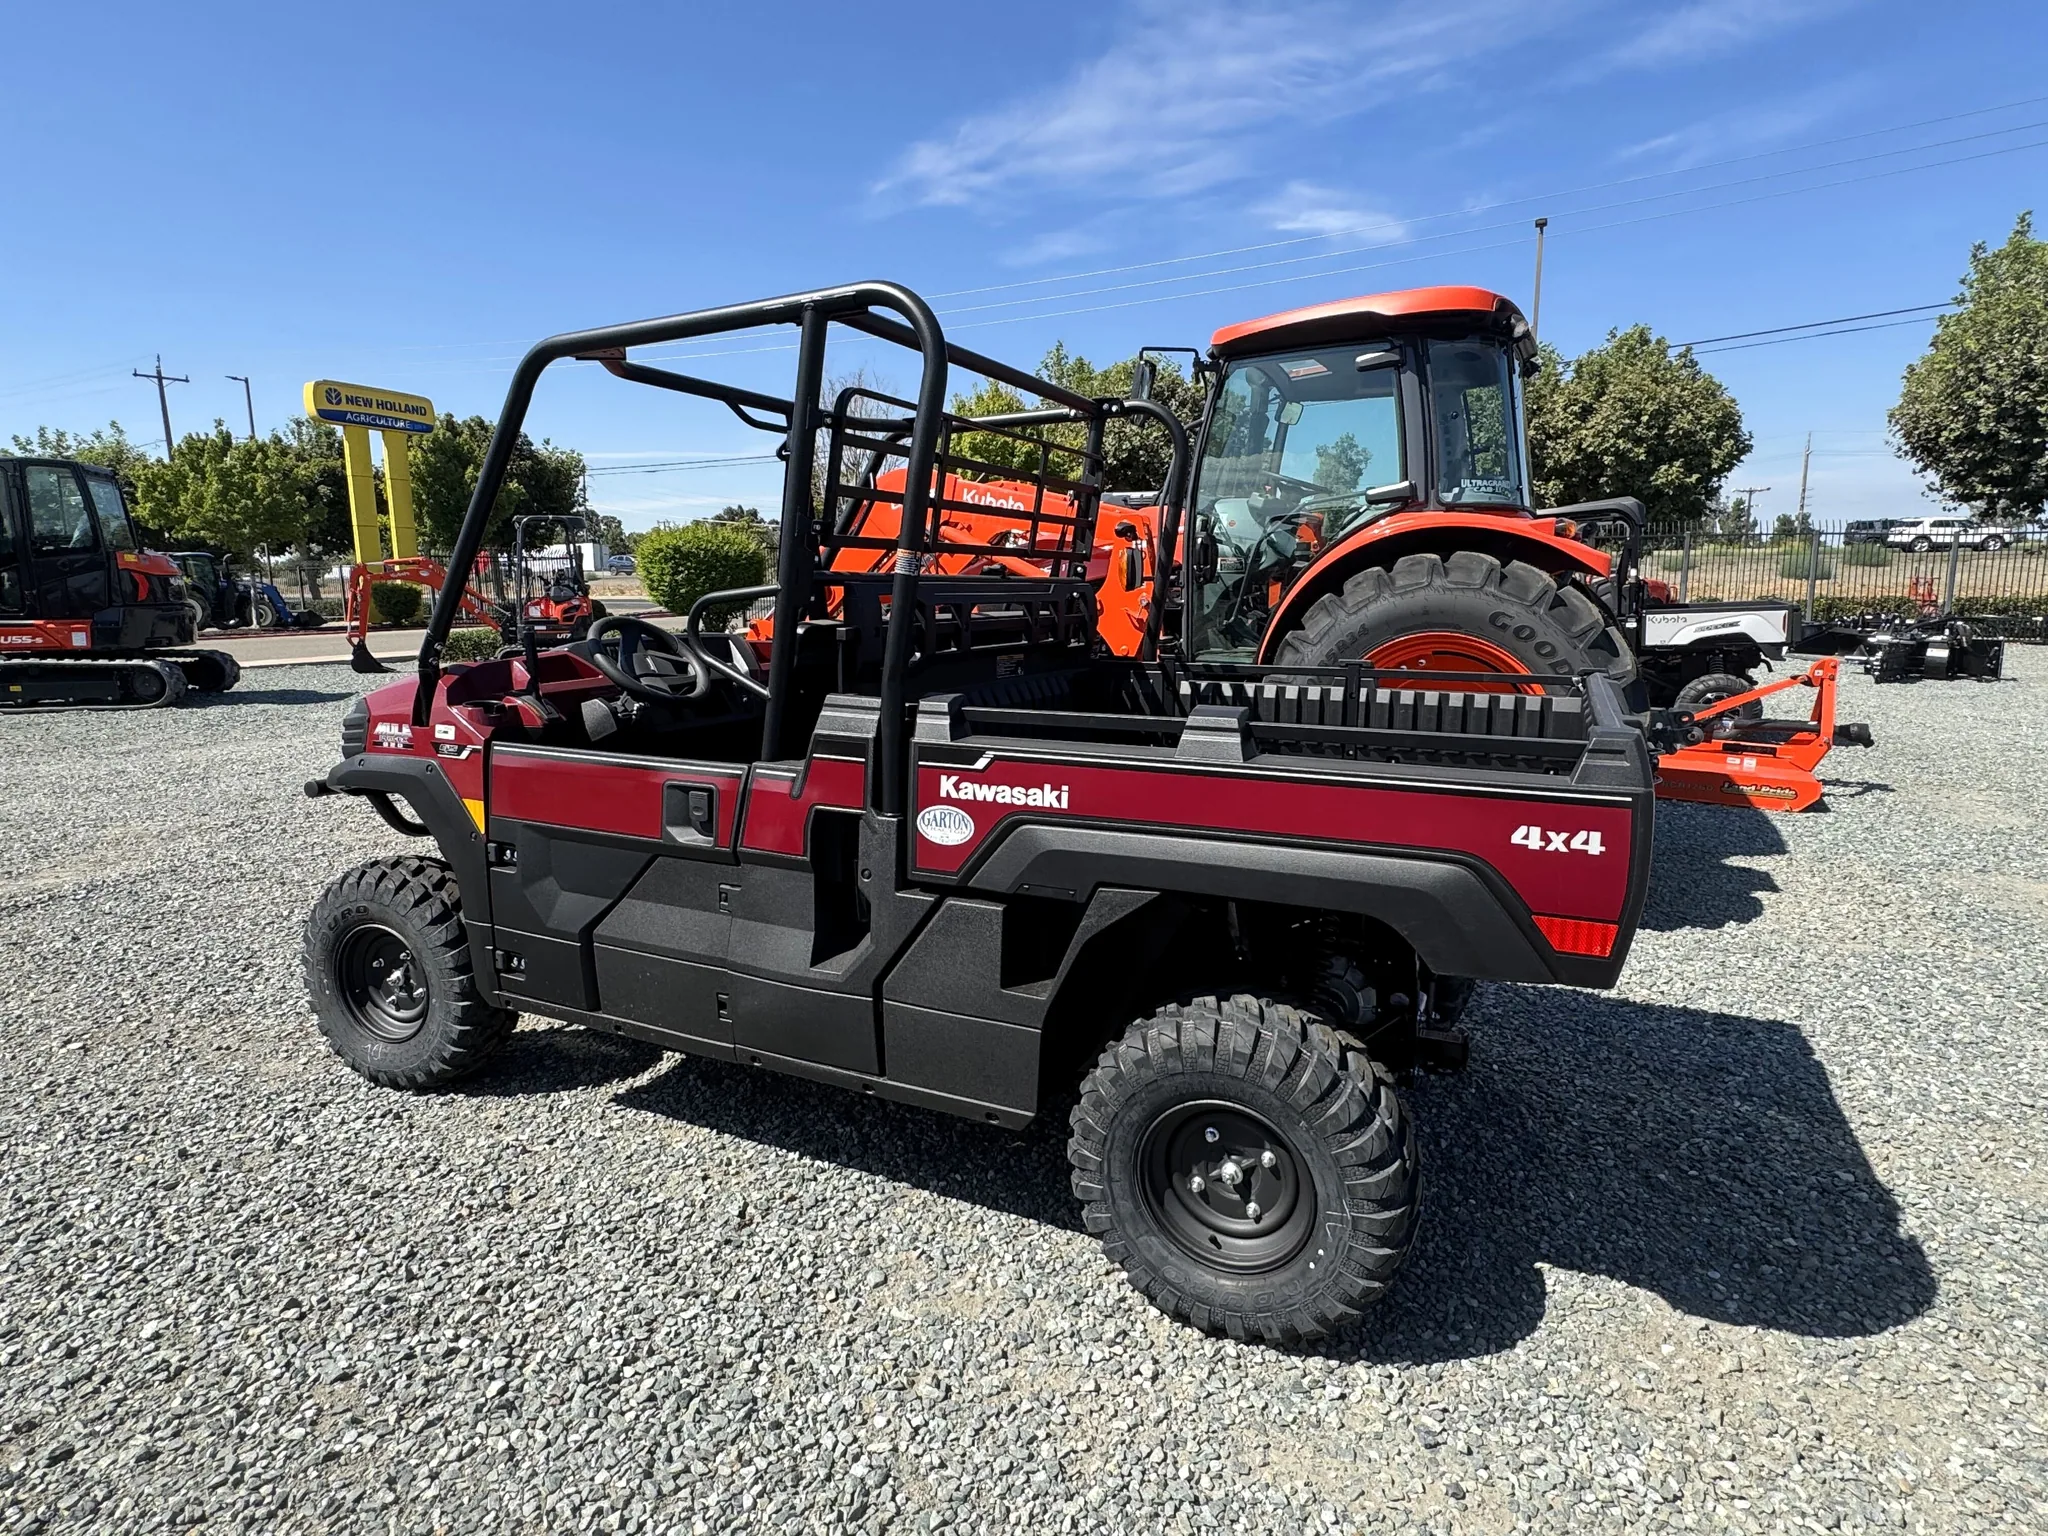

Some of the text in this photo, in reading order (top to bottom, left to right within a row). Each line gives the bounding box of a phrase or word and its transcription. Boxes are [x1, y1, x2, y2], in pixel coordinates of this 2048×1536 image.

[345, 394, 427, 416] NEW HOLLAND
[345, 412, 411, 429] AGRICULTURE
[1648, 615, 1687, 624] Kubota
[373, 722, 413, 737] MULE
[939, 774, 1069, 809] Kawasaki
[1724, 782, 1796, 796] Land Pride
[920, 810, 969, 831] GARTON
[1510, 825, 1606, 856] 4x4
